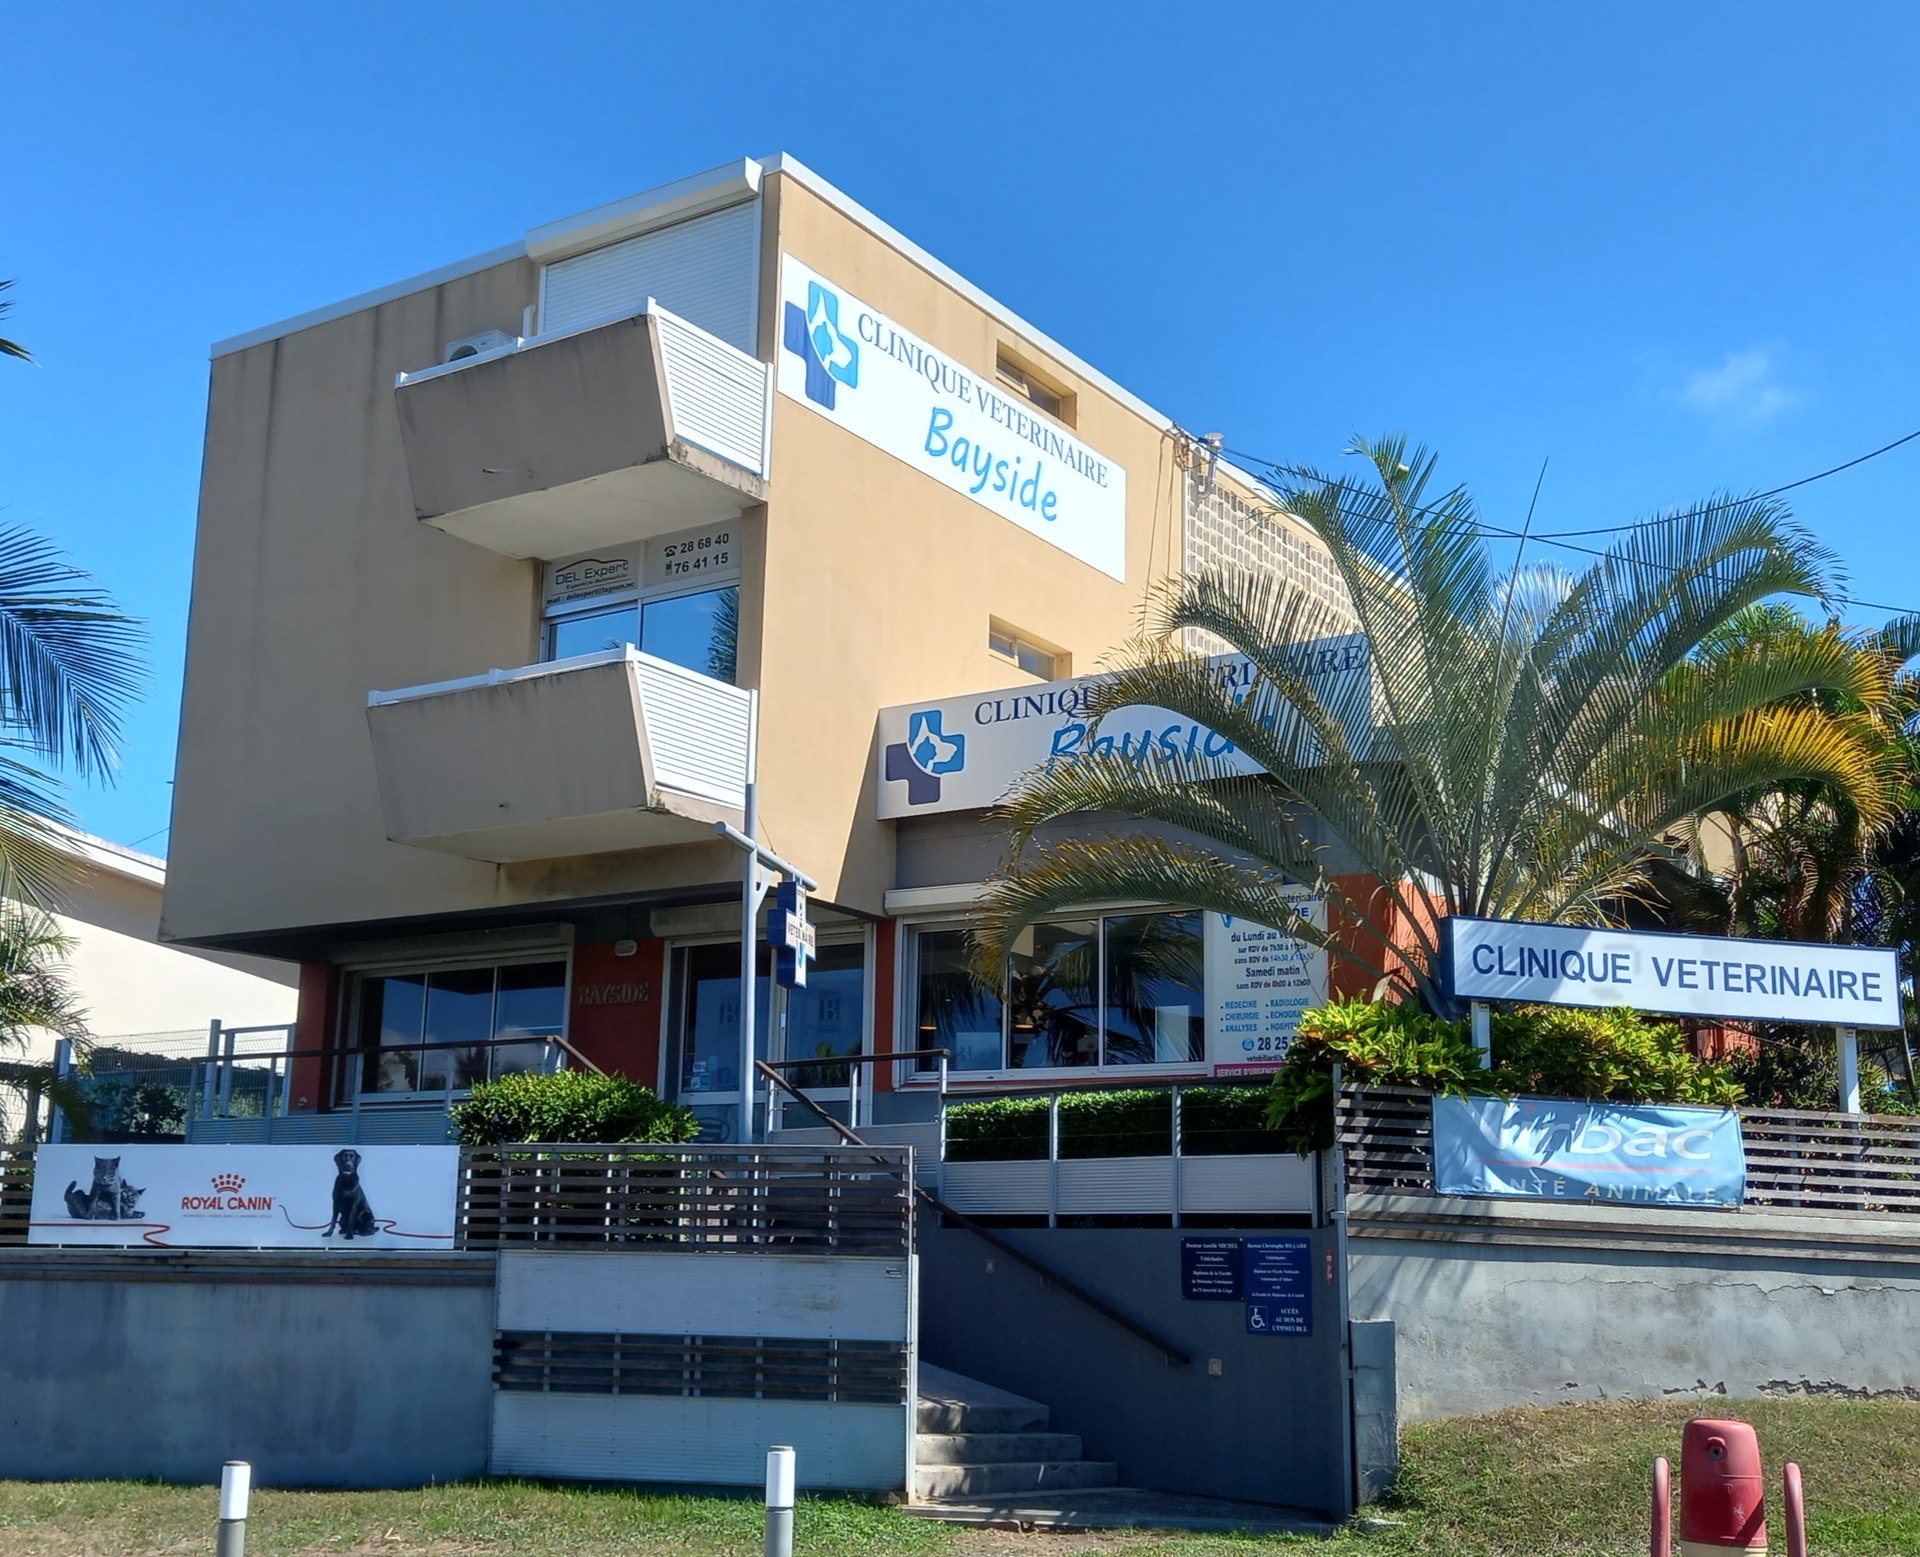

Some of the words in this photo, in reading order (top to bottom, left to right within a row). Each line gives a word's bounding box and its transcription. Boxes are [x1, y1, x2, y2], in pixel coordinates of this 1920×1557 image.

[858, 313, 971, 404] CLINIQUE
[975, 385, 1108, 488] VETERINAIRE
[924, 406, 1058, 522] Bayside
[680, 541, 694, 554] 28
[697, 537, 711, 550] 68
[715, 533, 729, 546] 40
[555, 573, 580, 585] DEL
[585, 562, 628, 579] Expert
[674, 561, 689, 575] 76
[693, 556, 708, 570] 41
[713, 552, 728, 566] 15
[974, 686, 1100, 726] CLINIQ
[1231, 932, 1241, 942] du
[1243, 931, 1265, 941] Lundi
[1246, 966, 1275, 977] Samedi
[1277, 966, 1300, 975] matin
[1472, 943, 1632, 984] CLINIQUE
[1651, 956, 1883, 1002] VETERINAIRE
[1225, 1024, 1258, 1032] ANALYSES
[1257, 1037, 1271, 1051] 28
[1274, 1036, 1288, 1050] 25
[1584, 1182, 1715, 1202] ANIMALE
[181, 1196, 224, 1210] ROYAL
[227, 1196, 272, 1210] CANIN
